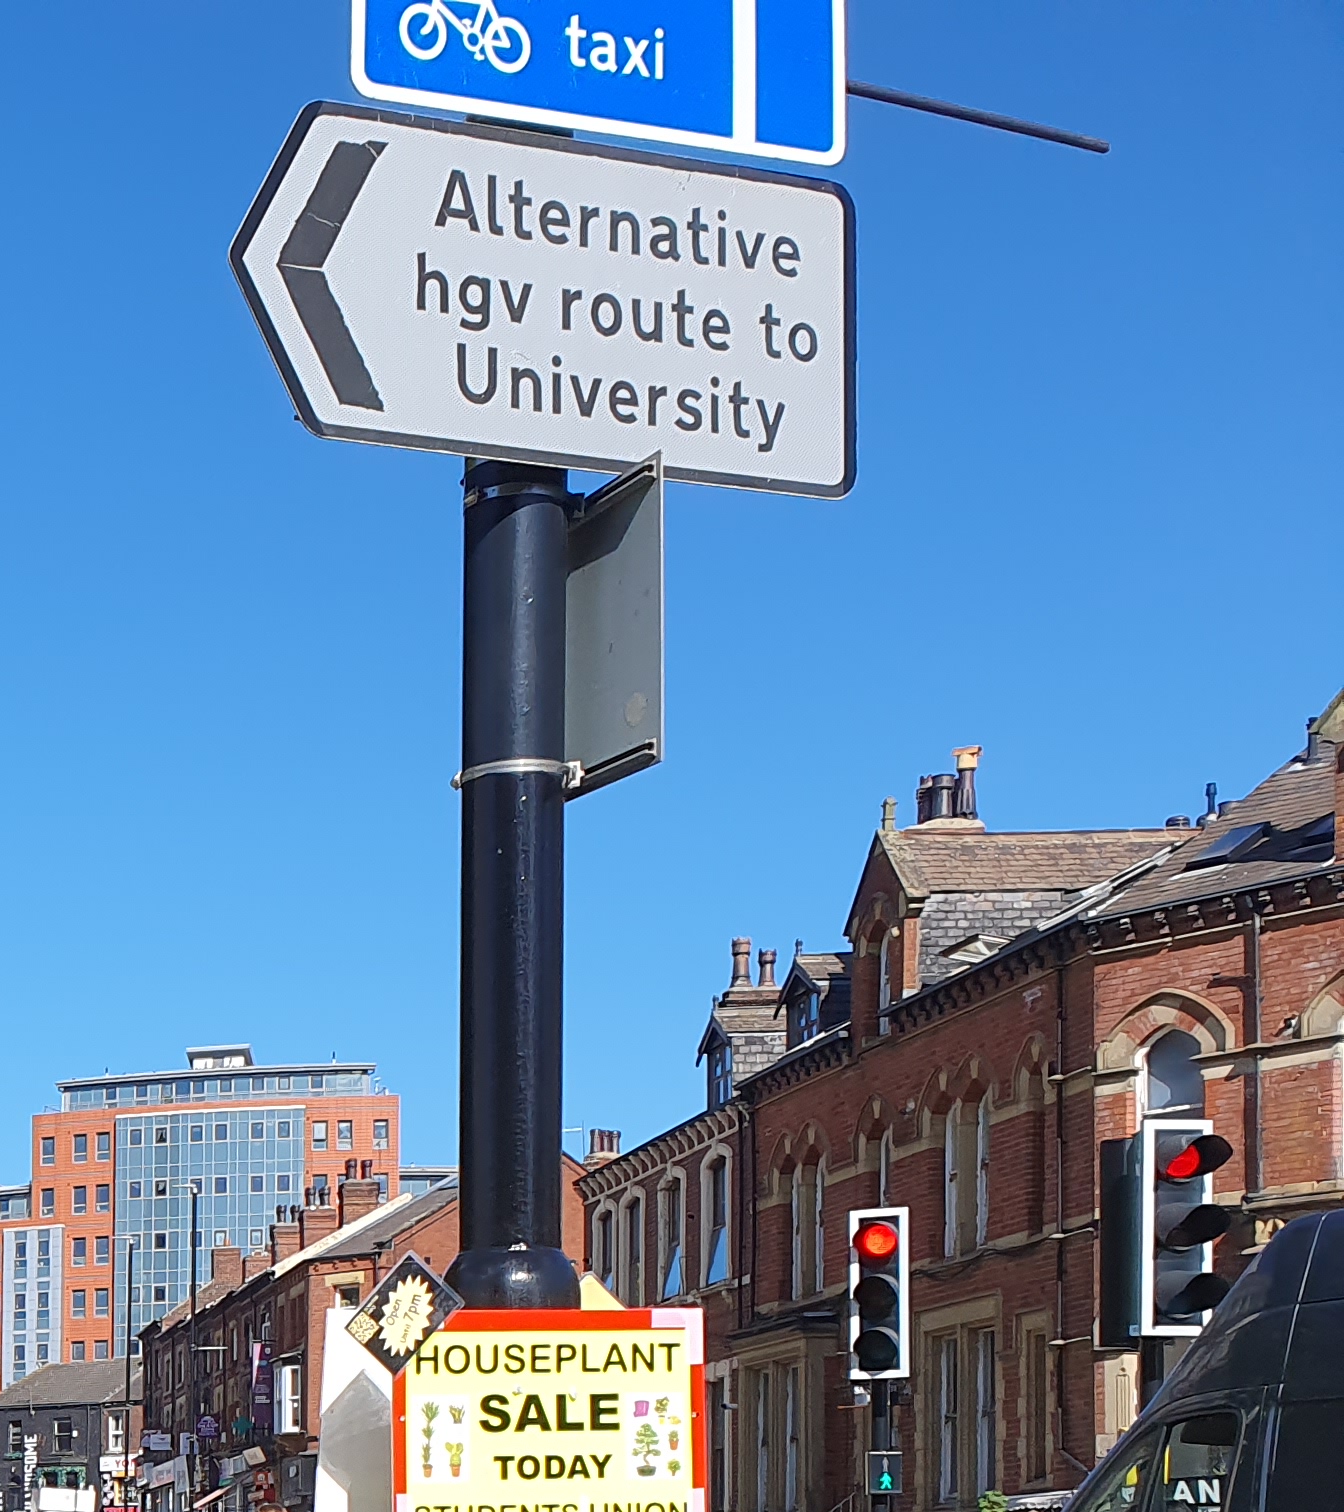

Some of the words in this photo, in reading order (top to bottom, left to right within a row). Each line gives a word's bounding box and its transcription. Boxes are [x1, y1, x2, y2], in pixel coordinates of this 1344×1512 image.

[564, 14, 666, 81] taxi
[434, 168, 802, 279] Alternative
[415, 252, 532, 332] hgv
[561, 288, 732, 352] route
[759, 302, 819, 364] to
[455, 342, 787, 453] University
[415, 1342, 682, 1376] HOUSEPLANT
[479, 1393, 621, 1433] SALE
[493, 1454, 613, 1481] TODAY
